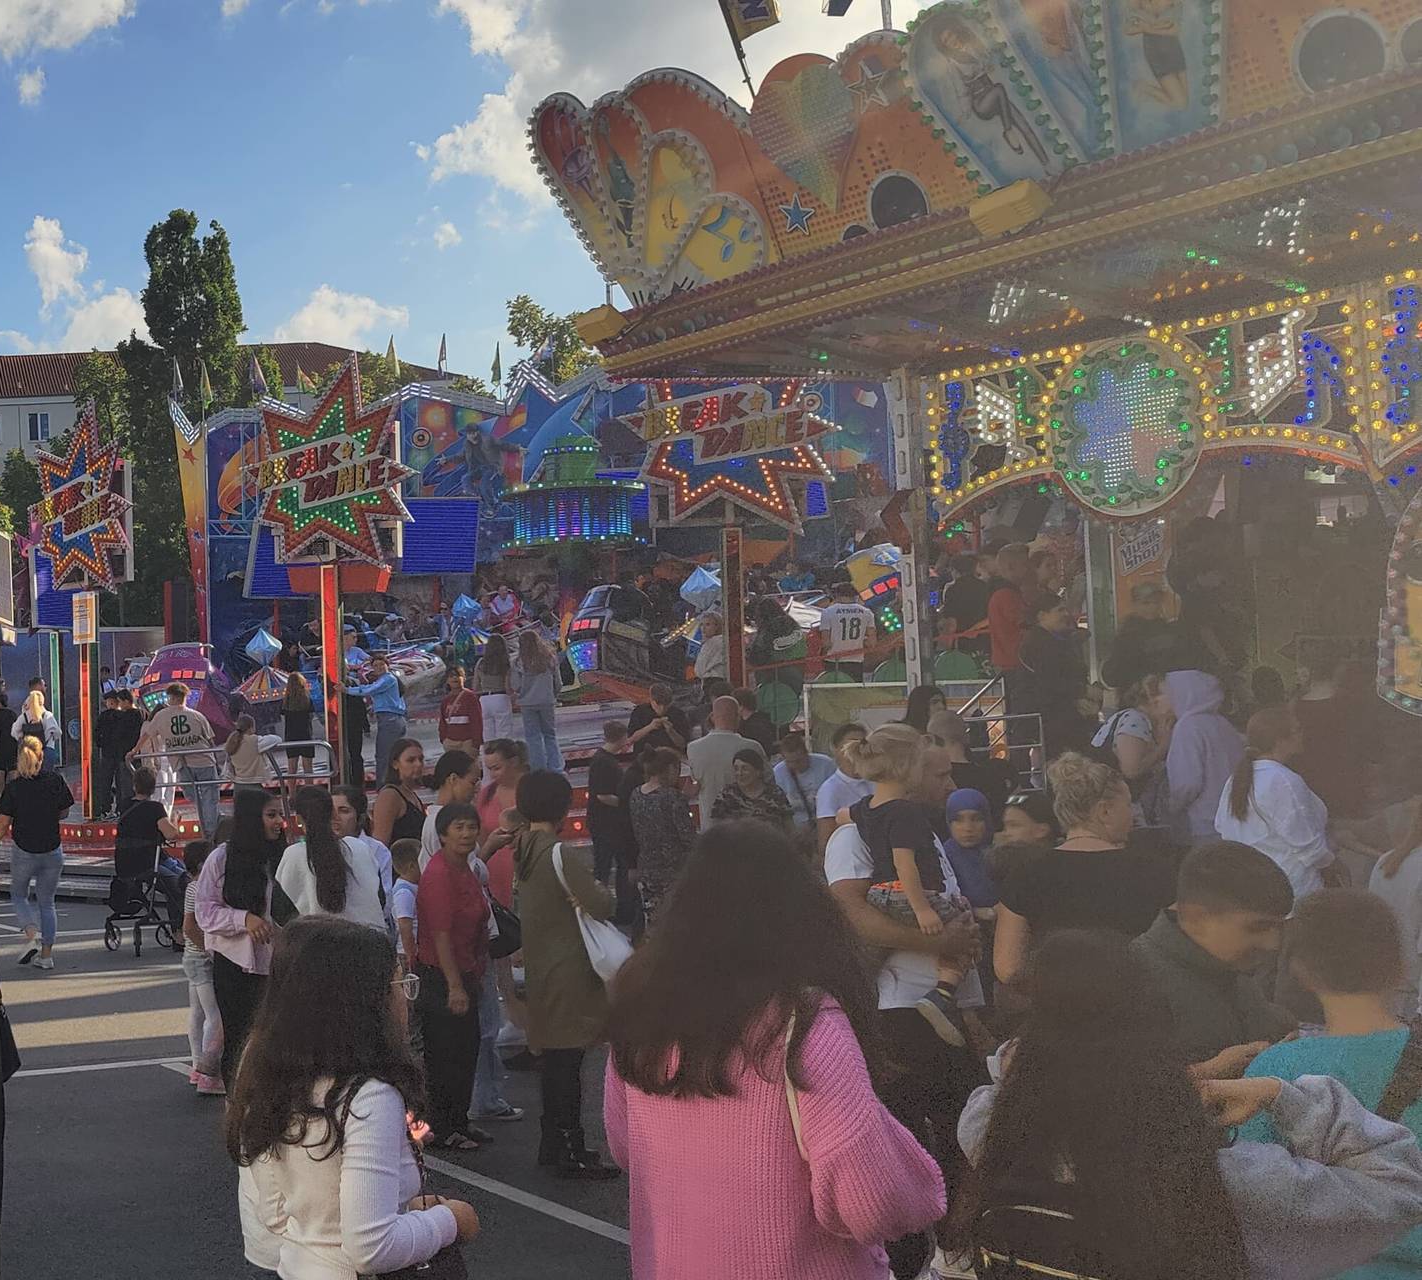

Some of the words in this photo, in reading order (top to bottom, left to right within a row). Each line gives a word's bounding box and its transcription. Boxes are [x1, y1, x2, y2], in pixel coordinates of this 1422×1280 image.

[643, 391, 750, 442] BREAK
[695, 409, 804, 459] DANCE
[257, 440, 342, 492] BREAK
[300, 457, 386, 503] DANCE
[839, 616, 862, 641] 18
[170, 714, 192, 737] BB
